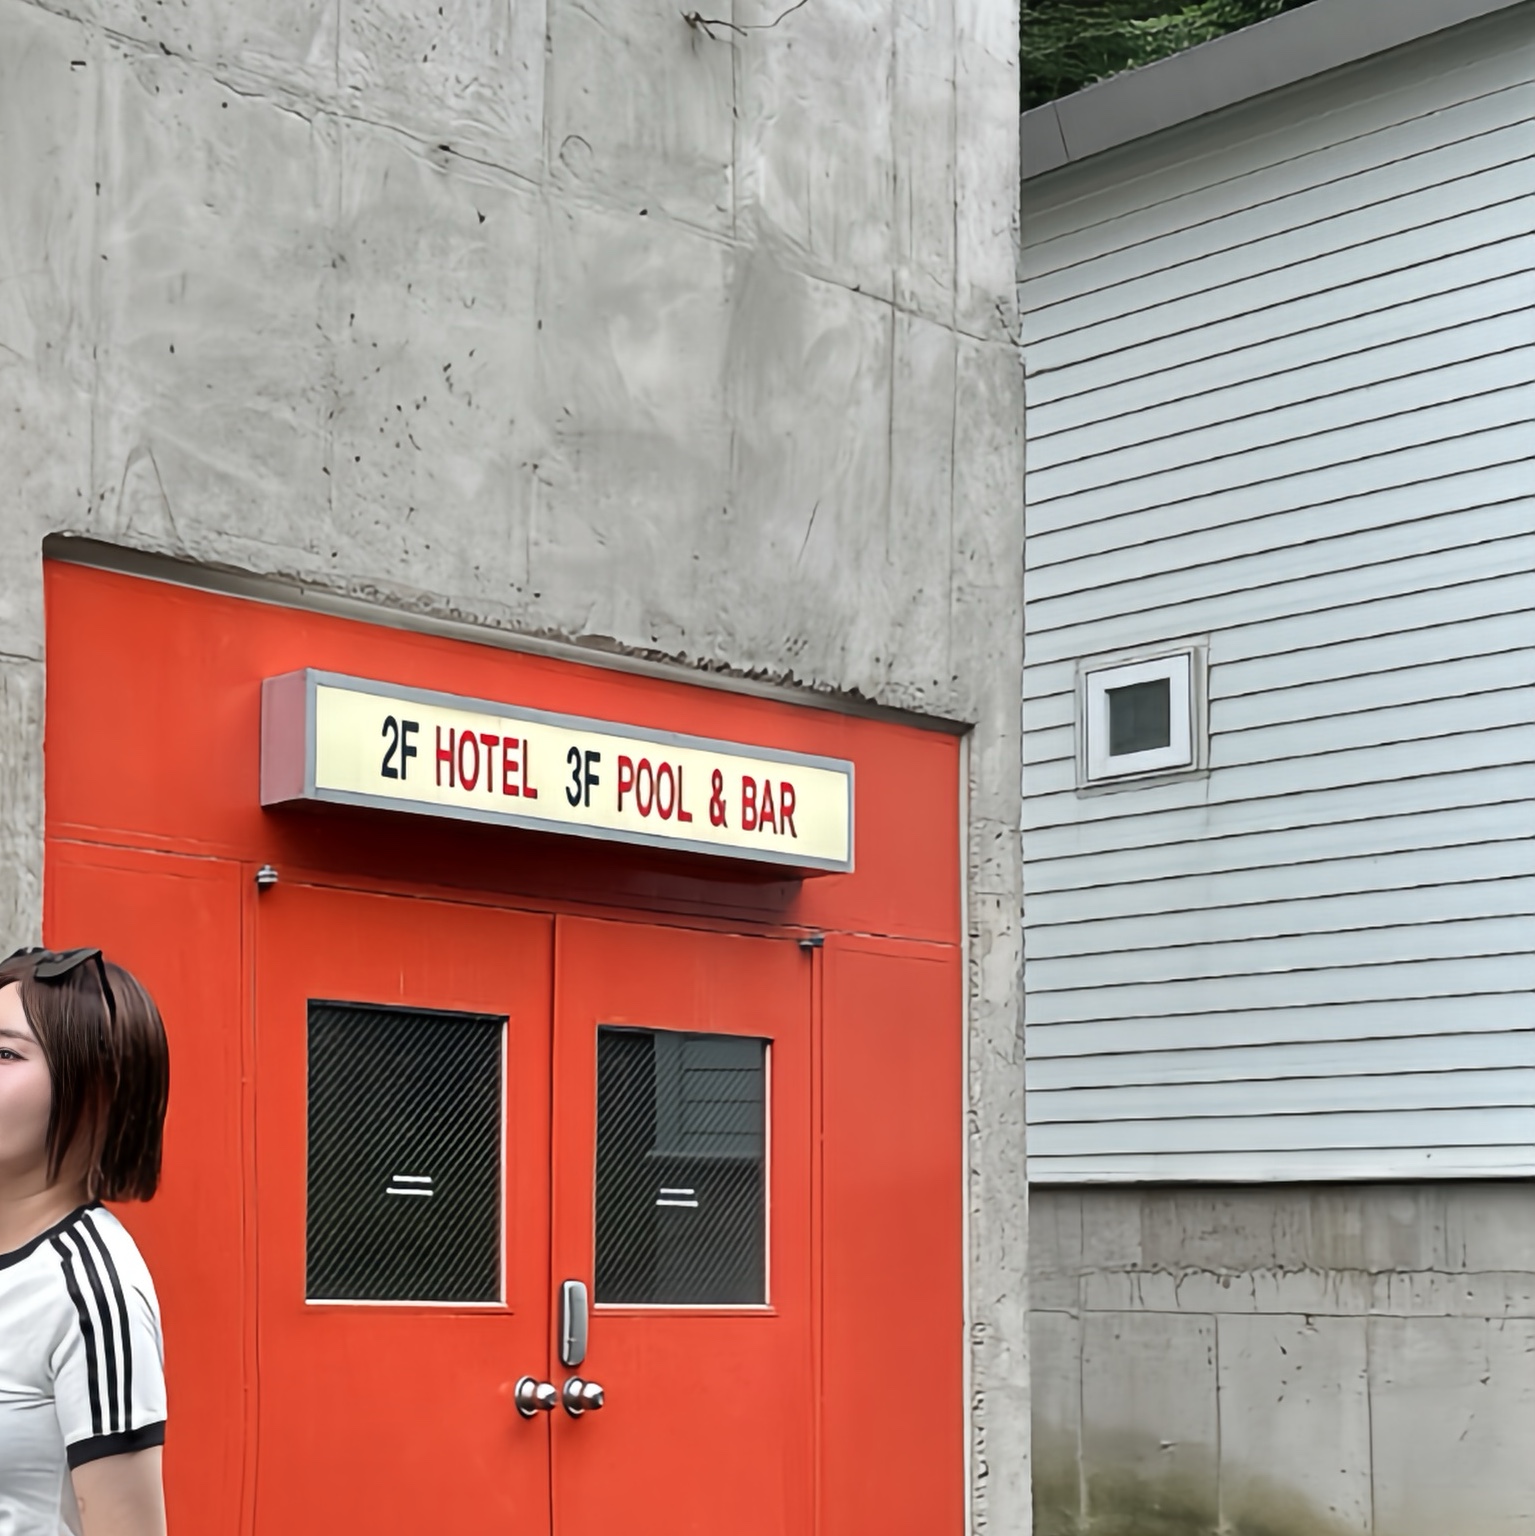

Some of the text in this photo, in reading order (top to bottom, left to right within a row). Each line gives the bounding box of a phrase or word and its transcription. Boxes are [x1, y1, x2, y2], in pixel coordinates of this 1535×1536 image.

[380, 715, 798, 839] 2F HOTEL 3F POOL & BAR
